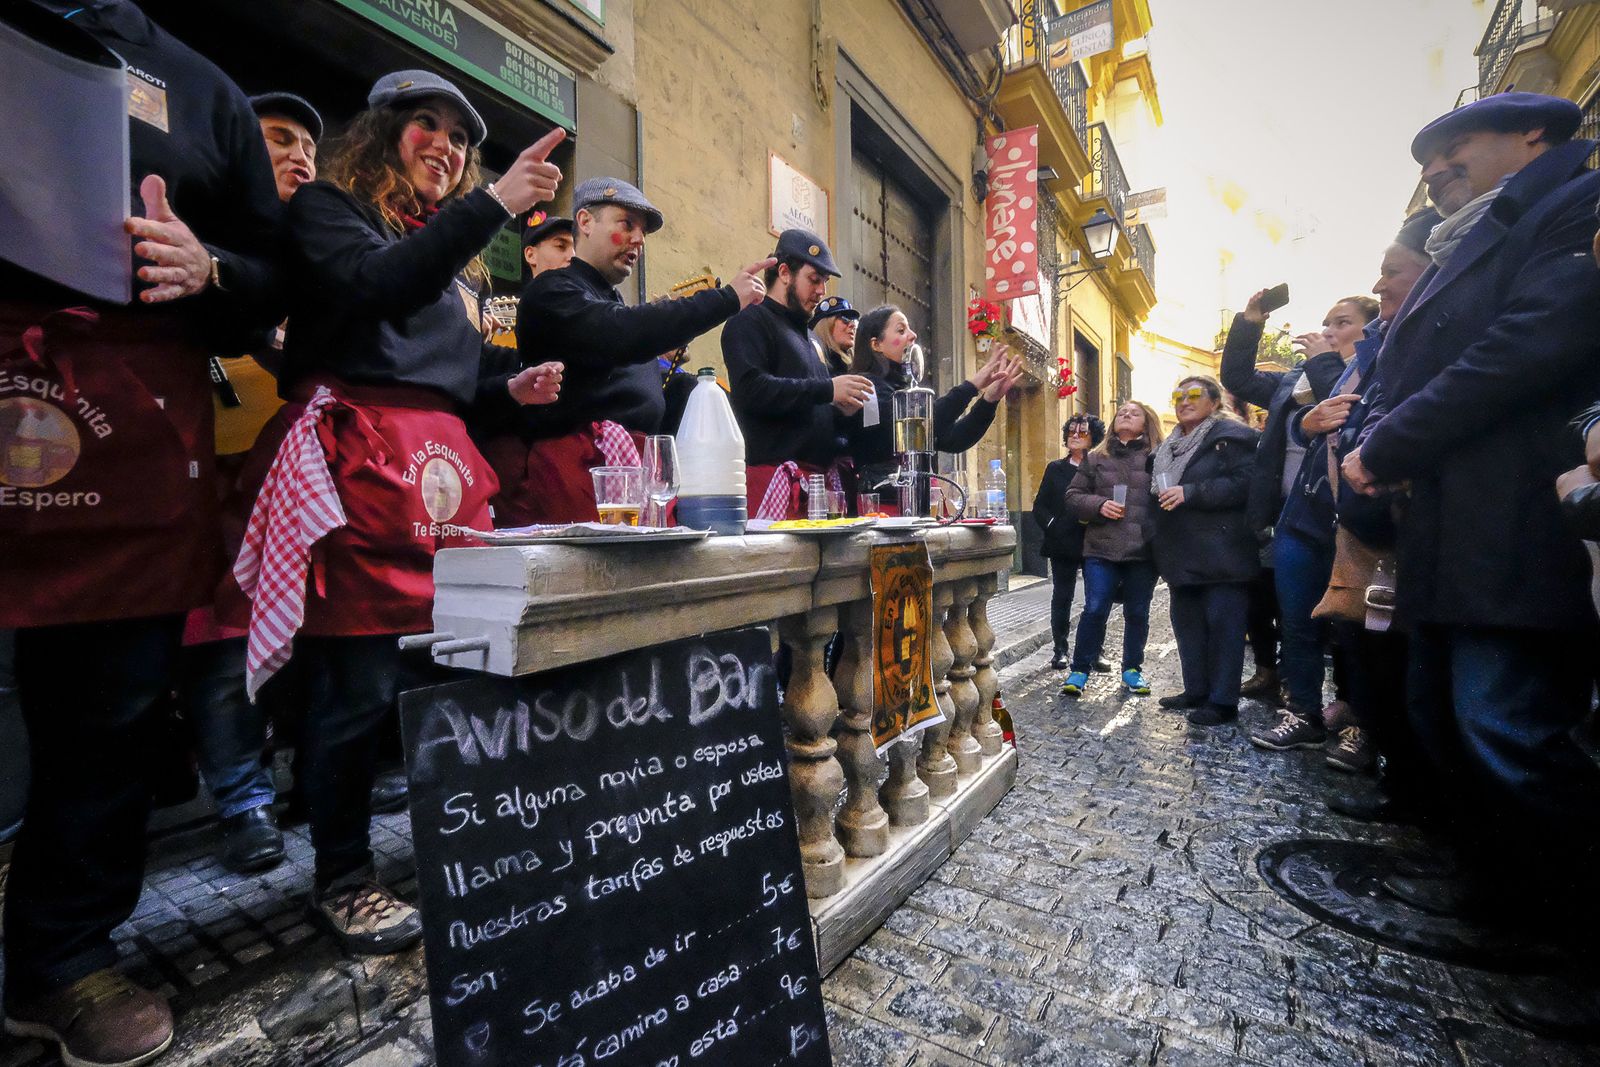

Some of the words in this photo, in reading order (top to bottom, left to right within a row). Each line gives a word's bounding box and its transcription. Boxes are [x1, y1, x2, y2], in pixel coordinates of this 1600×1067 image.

[1063, 19, 1097, 37] Fuentes
[1067, 2, 1110, 24] Alejandro
[1073, 39, 1107, 57] DENTAL
[0, 371, 113, 439] Esqunita
[0, 486, 102, 511] Espero
[402, 466, 418, 486] En
[411, 450, 427, 465] la
[424, 440, 474, 487] Esquinita
[413, 521, 427, 537] Te
[606, 658, 674, 730] del
[688, 648, 775, 726] Bar
[439, 792, 486, 835] Si
[495, 783, 587, 829] alguna
[600, 756, 664, 790] novia
[675, 755, 687, 769] o
[693, 734, 764, 767] esposa
[443, 850, 543, 897] llama
[551, 839, 574, 874] y
[584, 791, 696, 855] pregunta
[708, 779, 733, 812] por
[741, 759, 784, 786] usted
[583, 856, 665, 901] tarifas
[673, 844, 695, 867] de
[700, 807, 785, 857] respuestas
[522, 999, 563, 1035] Se
[569, 964, 637, 1010] acaba
[644, 947, 668, 968] de
[674, 931, 698, 952] ir
[594, 1007, 668, 1060] camino
[674, 994, 689, 1011] a
[697, 964, 742, 998] casa
[770, 926, 802, 955] 7€
[690, 1005, 740, 1058] está
[780, 974, 808, 1000] 9€
